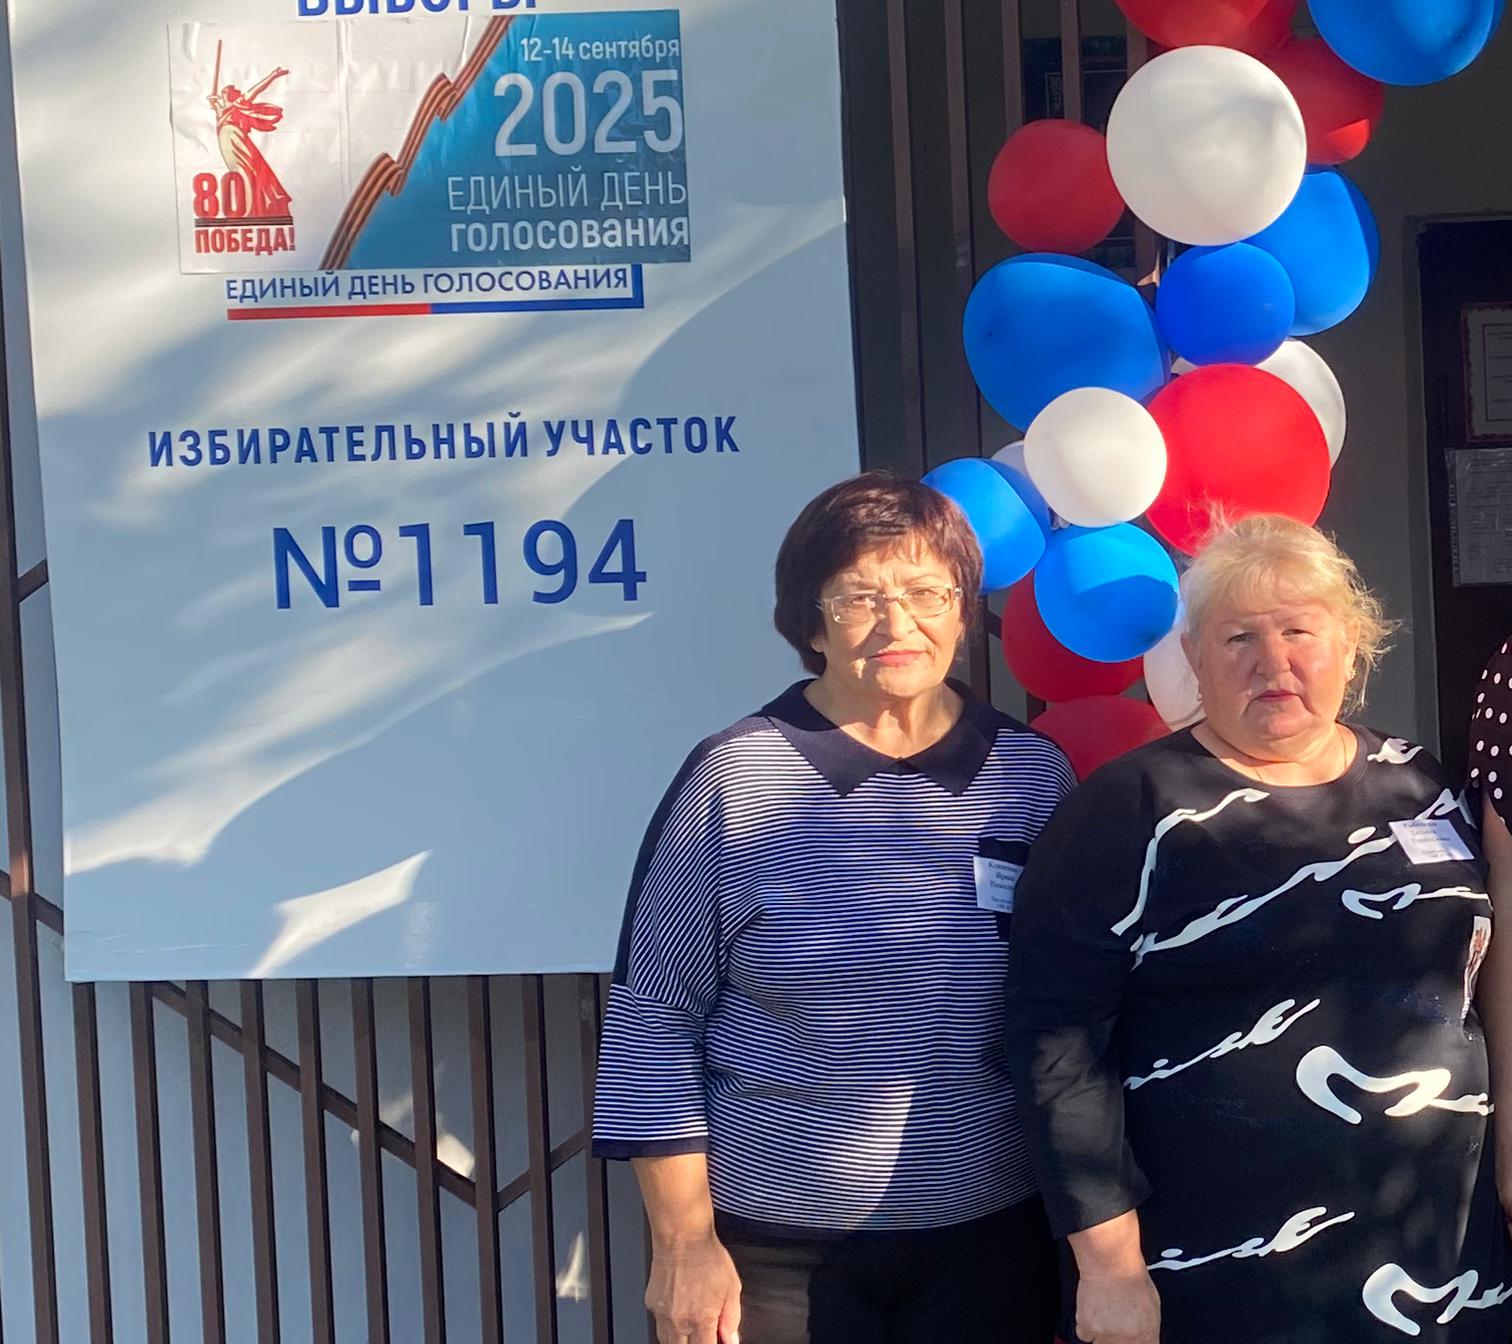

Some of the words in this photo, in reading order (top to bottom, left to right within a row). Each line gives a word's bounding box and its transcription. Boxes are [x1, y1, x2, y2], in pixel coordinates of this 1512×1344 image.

[520, 37, 575, 61] 12-14
[578, 36, 681, 60] сентября
[494, 69, 684, 157] 2025
[192, 172, 249, 220] 80
[448, 167, 590, 213] ЕДИНЫЙ
[601, 169, 687, 209] ДЕНЬ
[195, 225, 296, 256] ПОБЕДА!
[226, 270, 340, 303] ЕДИНЫЙ
[348, 270, 414, 300] ДЕНЬ
[422, 267, 629, 294] ГОЛОСОВАНИЯ
[147, 412, 529, 468] ИЗБИРАТЕЛЬНЫЙ
[543, 414, 741, 458] УЧАСТОК
[272, 518, 648, 610] №1194
